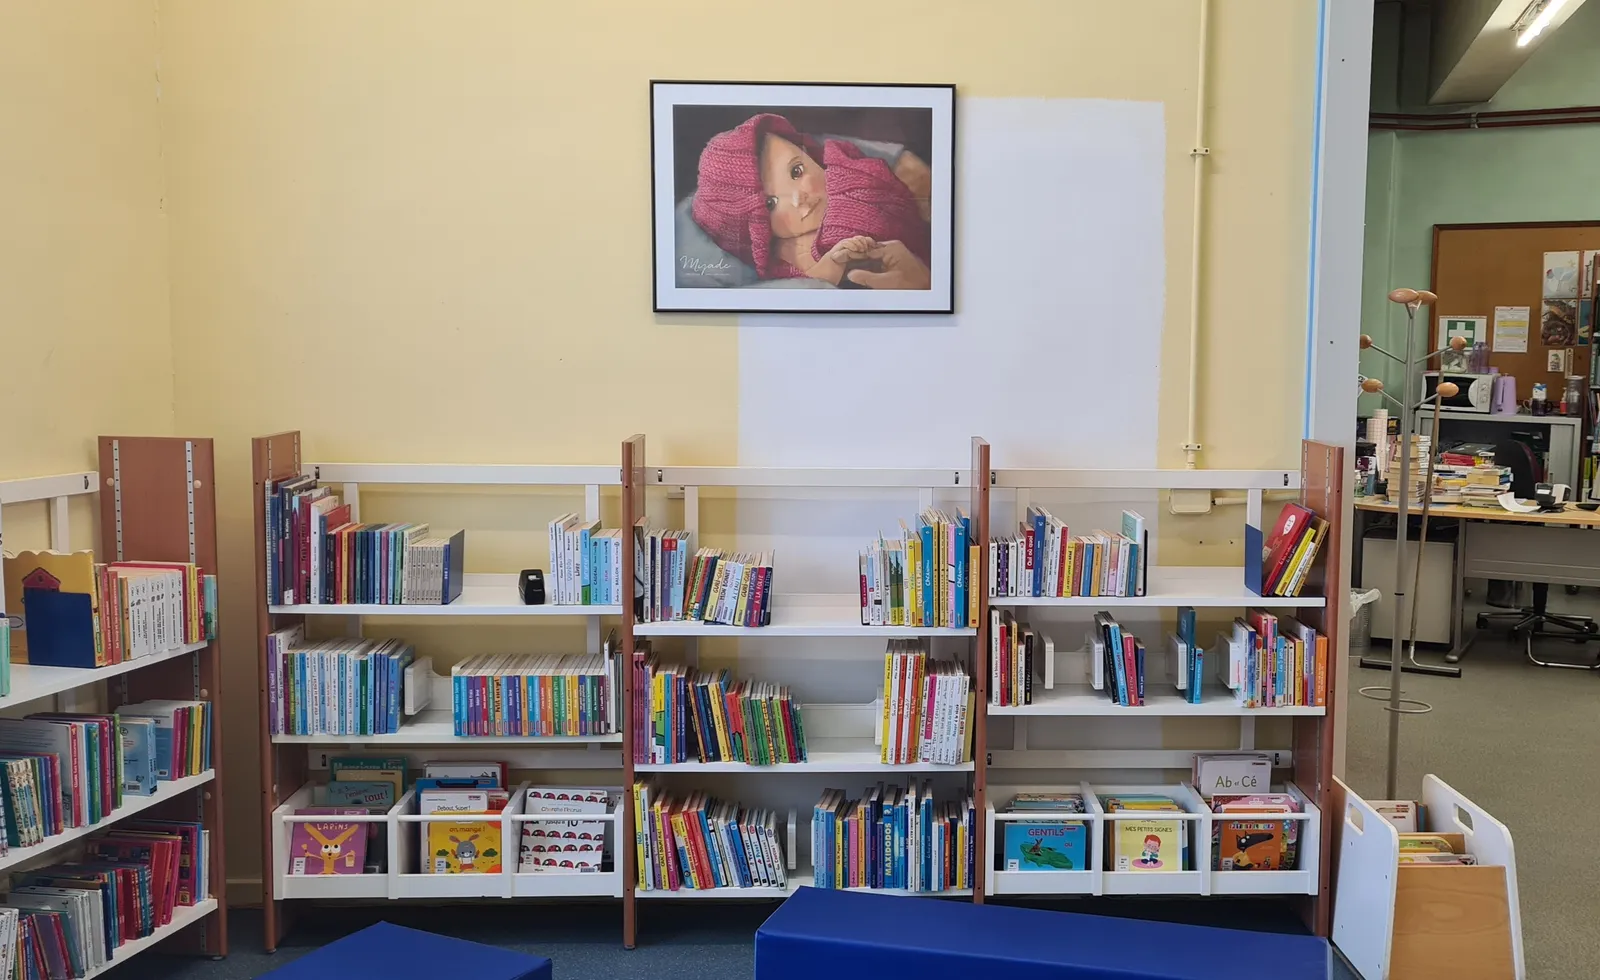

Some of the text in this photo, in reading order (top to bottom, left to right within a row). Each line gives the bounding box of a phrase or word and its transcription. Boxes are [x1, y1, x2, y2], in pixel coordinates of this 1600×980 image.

[1215, 775, 1232, 788] Ab
[1241, 775, 1257, 788] Cé
[1028, 828, 1065, 836] GENTILS
